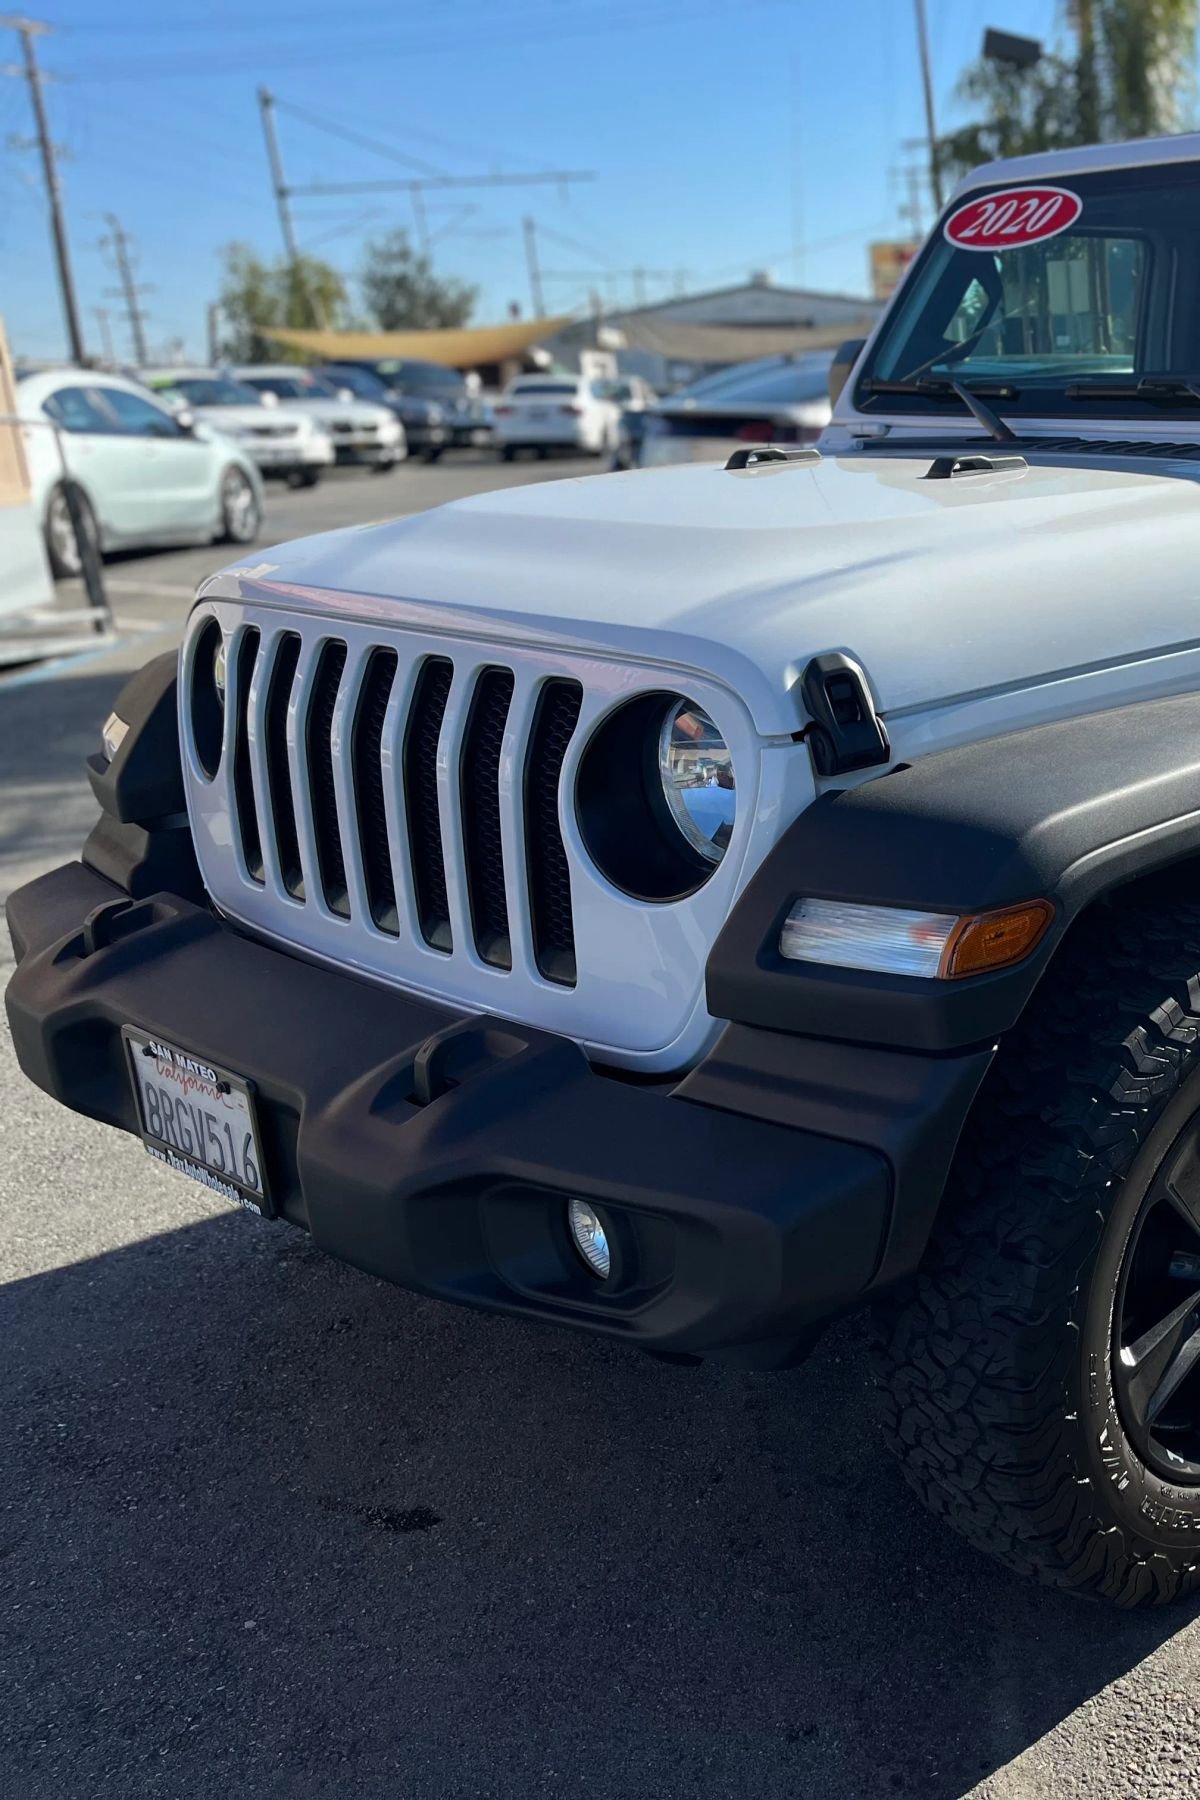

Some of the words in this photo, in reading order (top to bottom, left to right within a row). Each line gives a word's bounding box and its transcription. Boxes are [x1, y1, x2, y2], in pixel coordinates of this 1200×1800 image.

[956, 195, 1063, 238] 2020
[148, 1041, 172, 1061] SAN
[175, 1054, 217, 1082] MATEO
[145, 1082, 259, 1191] 8RGV516
